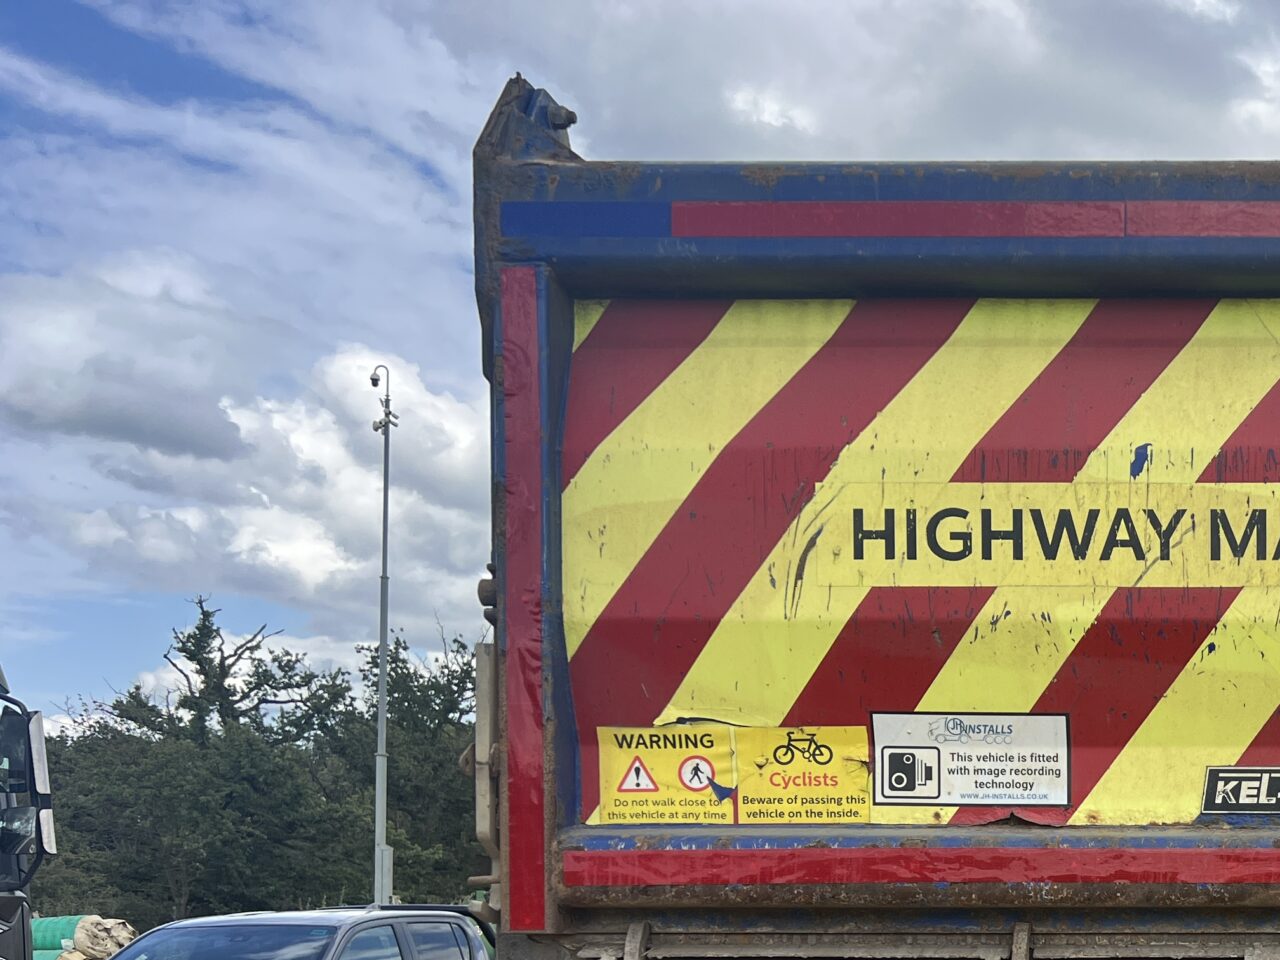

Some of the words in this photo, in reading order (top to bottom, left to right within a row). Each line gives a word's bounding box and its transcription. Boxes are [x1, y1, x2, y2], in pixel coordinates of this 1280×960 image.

[853, 507, 1187, 561] HIGHWAY
[965, 724, 1013, 735] INSTALLS
[613, 733, 715, 749] WARNING
[949, 752, 973, 763] This
[976, 752, 1015, 763] vehicle
[1017, 752, 1027, 763] is
[1029, 752, 1059, 763] fitted
[947, 766, 970, 776] with
[973, 766, 1007, 778] image
[1009, 766, 1061, 778] recording
[769, 772, 838, 790] Cyclists
[974, 779, 1035, 792] technology
[614, 799, 629, 808] Do
[631, 799, 649, 808] not
[651, 798, 676, 807] walk
[678, 798, 706, 807] close
[709, 798, 720, 807] to
[742, 795, 784, 805] Beware
[786, 795, 799, 805] of
[800, 795, 843, 807] passing
[846, 795, 867, 805] this
[608, 811, 627, 820] this
[629, 811, 666, 820] vehicle
[668, 811, 679, 820] at
[681, 811, 701, 821] any
[703, 811, 728, 820] time
[746, 809, 785, 819] vehicle
[788, 809, 803, 819] on
[805, 809, 824, 819] the
[826, 809, 862, 819] inside.
